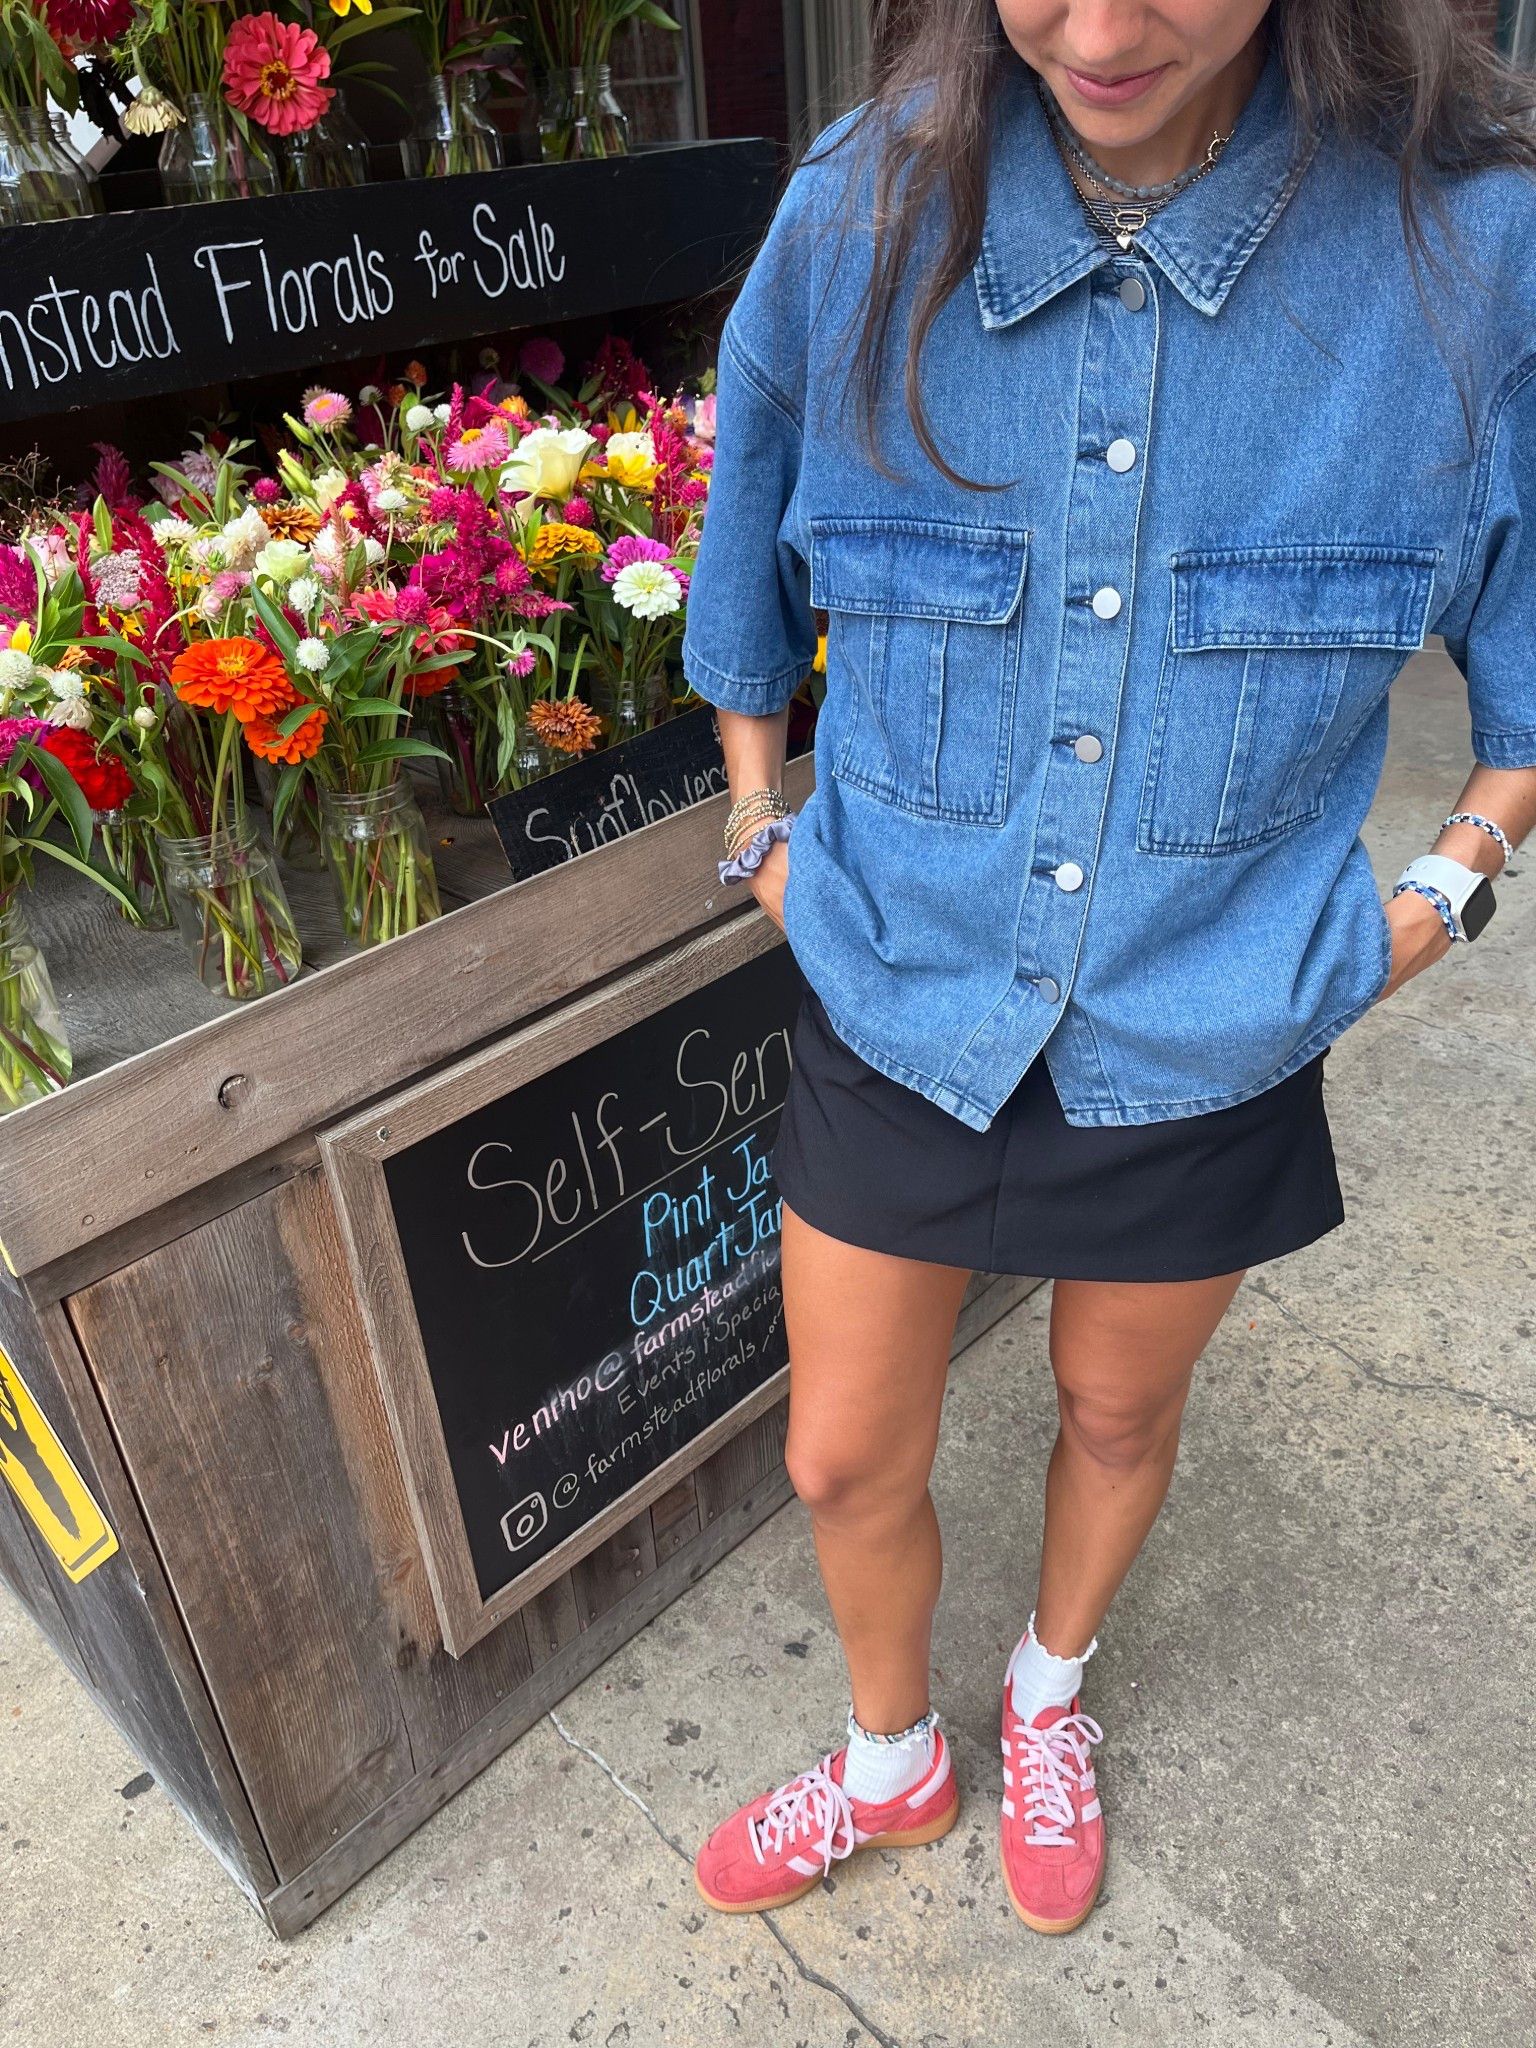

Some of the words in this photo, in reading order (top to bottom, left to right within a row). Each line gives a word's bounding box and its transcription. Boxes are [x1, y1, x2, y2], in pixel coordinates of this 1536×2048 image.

[194, 232, 394, 345] Florals
[414, 229, 466, 299] for
[471, 202, 566, 299] Sale
[461, 1027, 793, 1268] Self-Ser
[642, 1164, 716, 1258] Pint
[630, 1221, 736, 1326] Quart
[617, 1345, 696, 1415] Events
